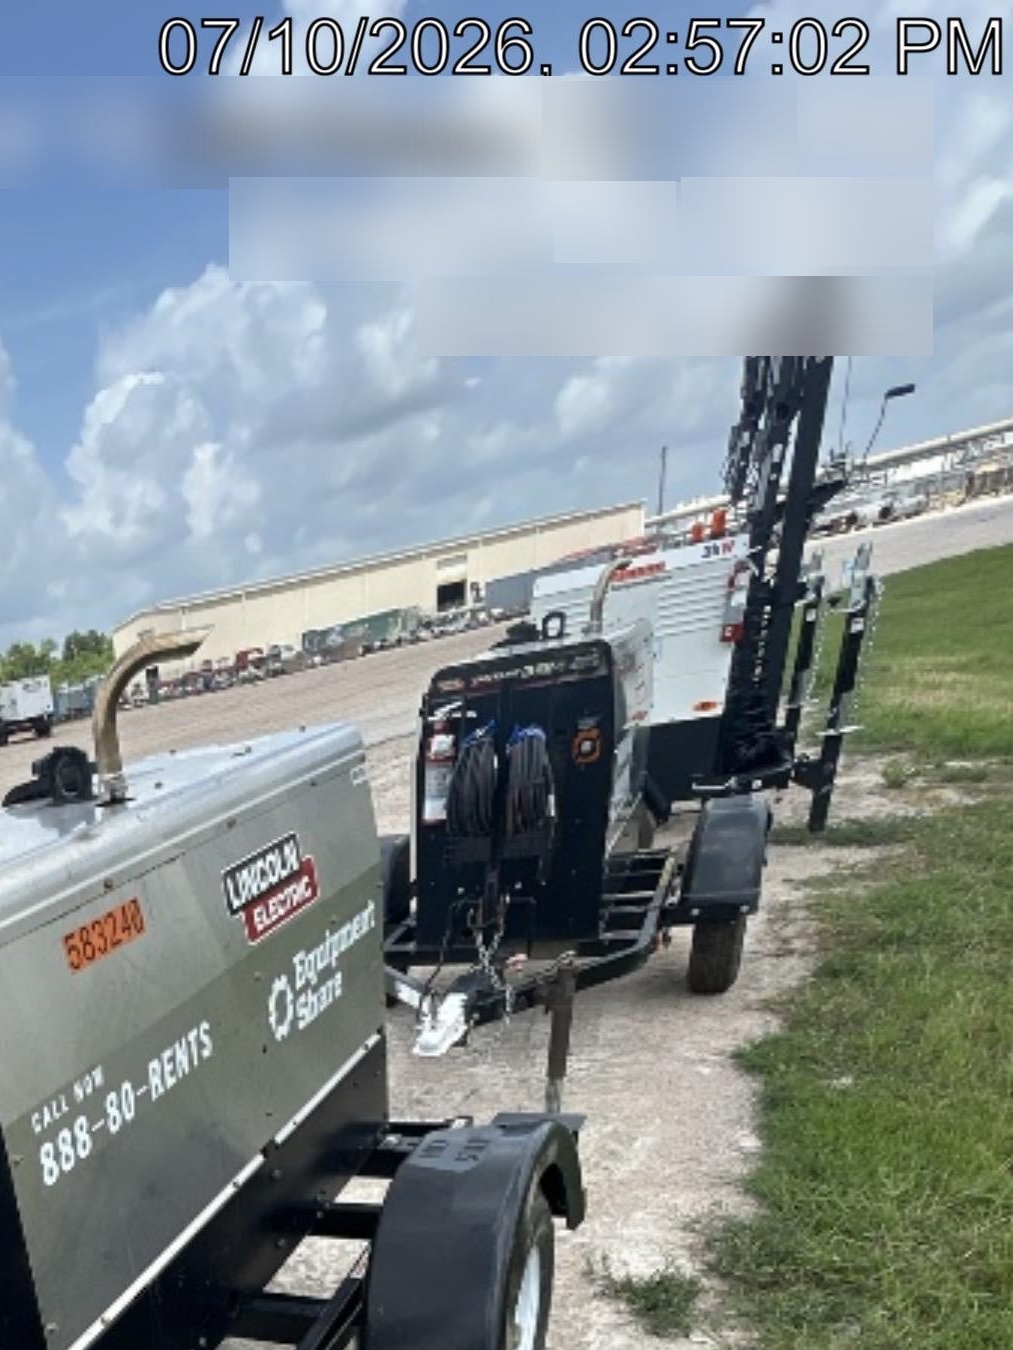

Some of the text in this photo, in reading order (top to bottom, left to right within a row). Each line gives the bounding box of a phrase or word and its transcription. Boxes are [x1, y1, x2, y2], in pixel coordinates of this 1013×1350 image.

[227, 839, 300, 910] LINCOLN
[253, 875, 313, 932] ELECTRIC
[64, 897, 144, 970] 583240
[293, 900, 376, 990] Equipment
[296, 972, 342, 1030] Share
[31, 1065, 105, 1134] CALL NOW
[40, 1020, 214, 1186] 888-80-RENTS
